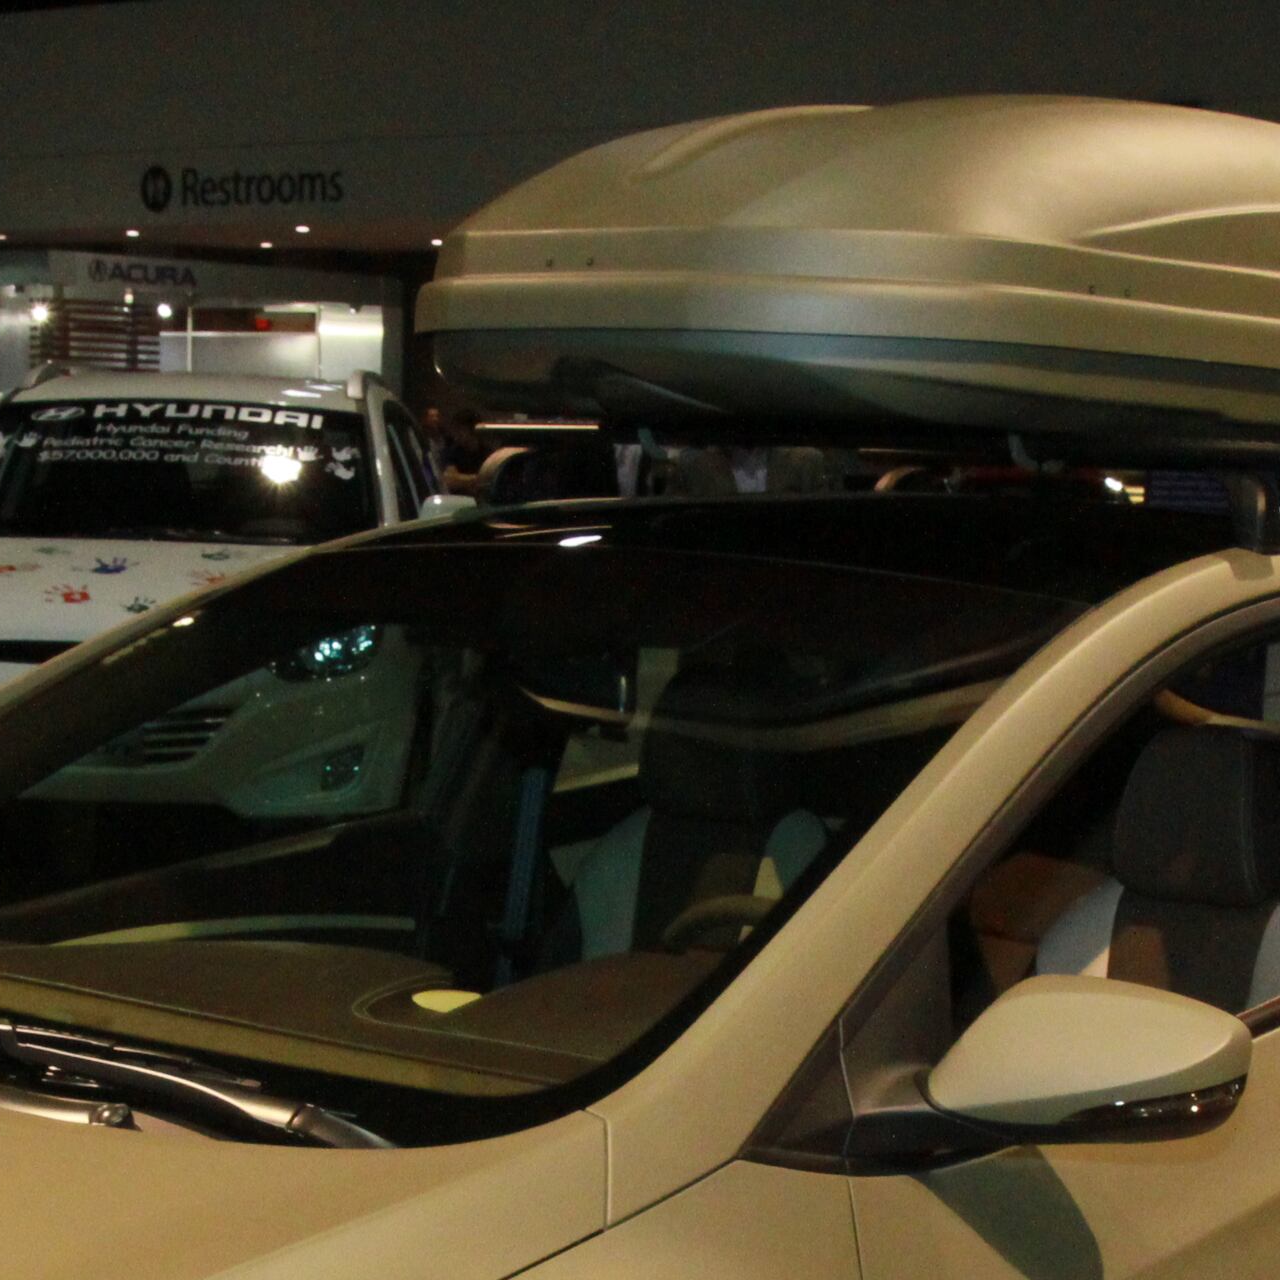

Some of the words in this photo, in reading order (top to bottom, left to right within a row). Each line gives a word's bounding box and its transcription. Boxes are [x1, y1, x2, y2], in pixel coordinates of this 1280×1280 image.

[181, 167, 344, 207] Restrooms
[92, 402, 324, 430] HYUNDAI
[95, 422, 171, 438] Hyundai
[176, 424, 251, 440] Funding
[42, 436, 122, 448] Pediatric
[129, 437, 194, 450] Cancer
[163, 451, 200, 464] and
